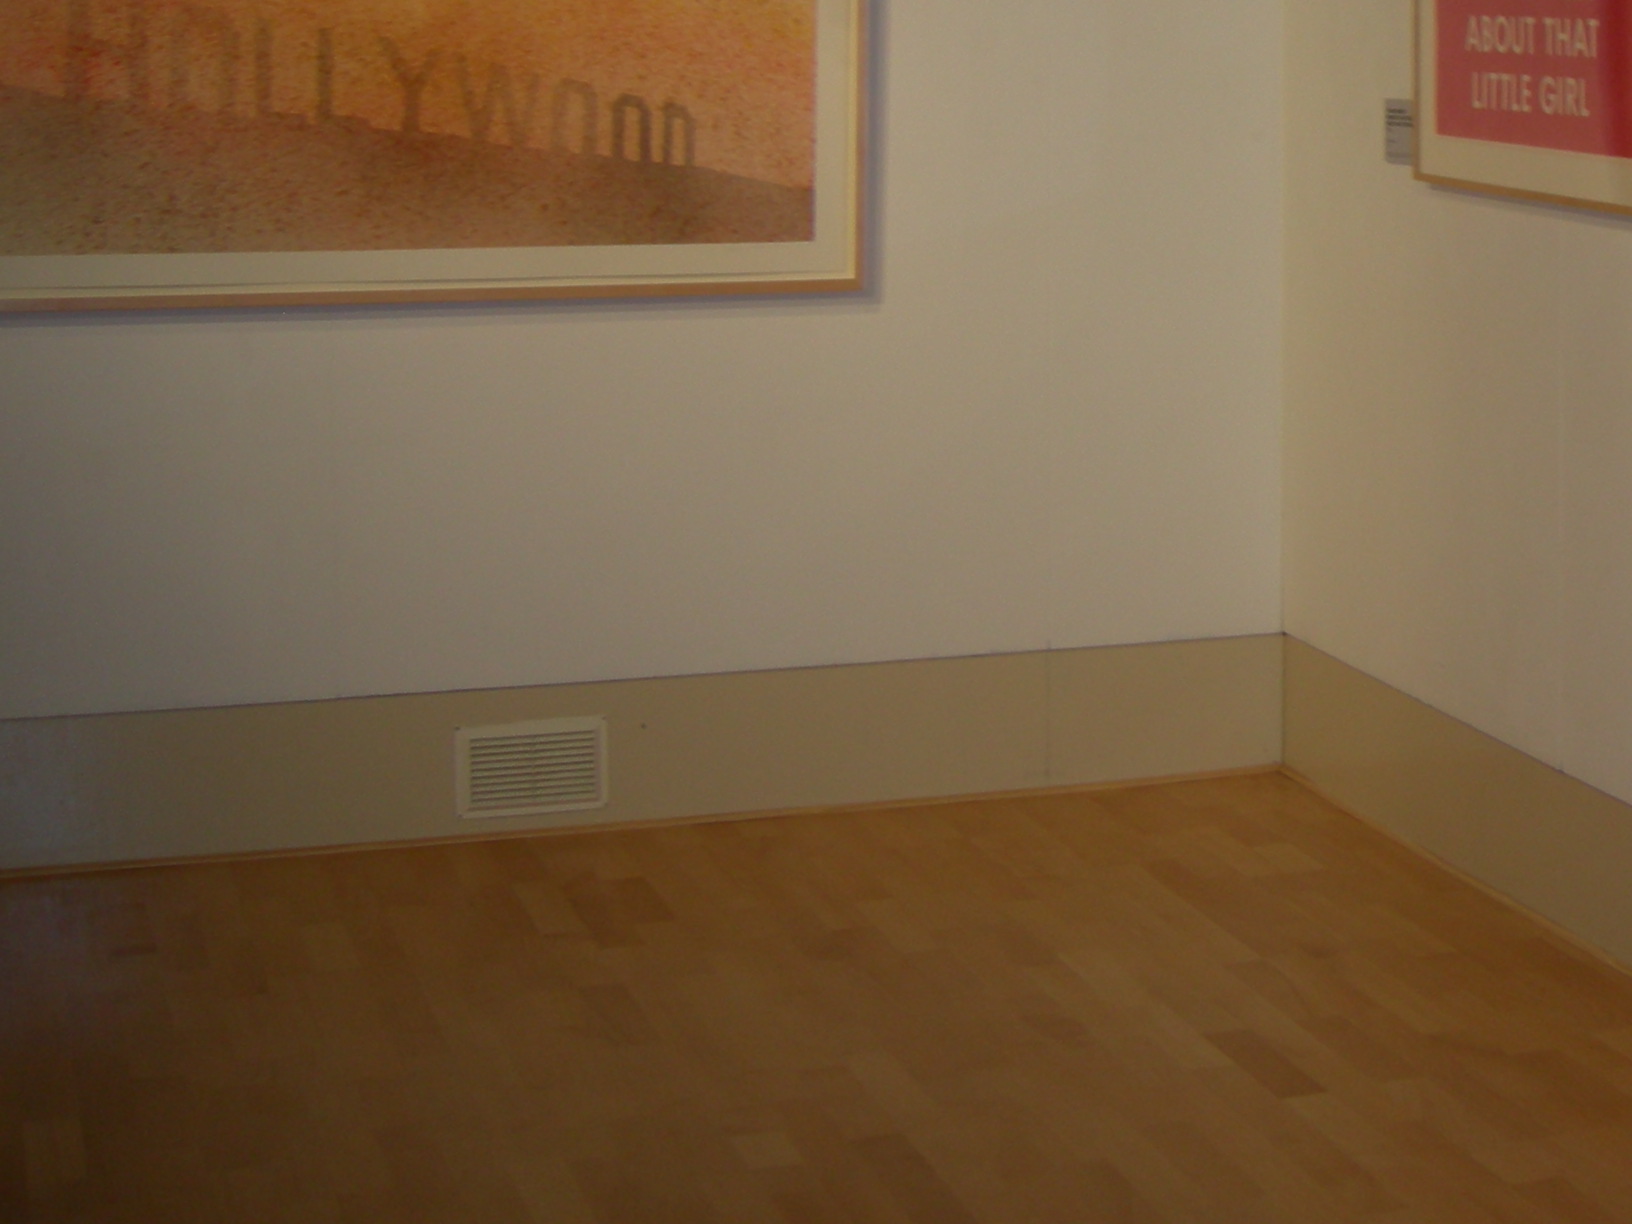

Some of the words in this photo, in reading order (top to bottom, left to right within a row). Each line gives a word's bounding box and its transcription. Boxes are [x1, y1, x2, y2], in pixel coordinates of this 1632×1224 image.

[1463, 14, 1536, 56] ABOUT
[1542, 16, 1600, 59] THAT
[1470, 71, 1533, 114] LITTLE
[1537, 74, 1591, 118] GIRL
